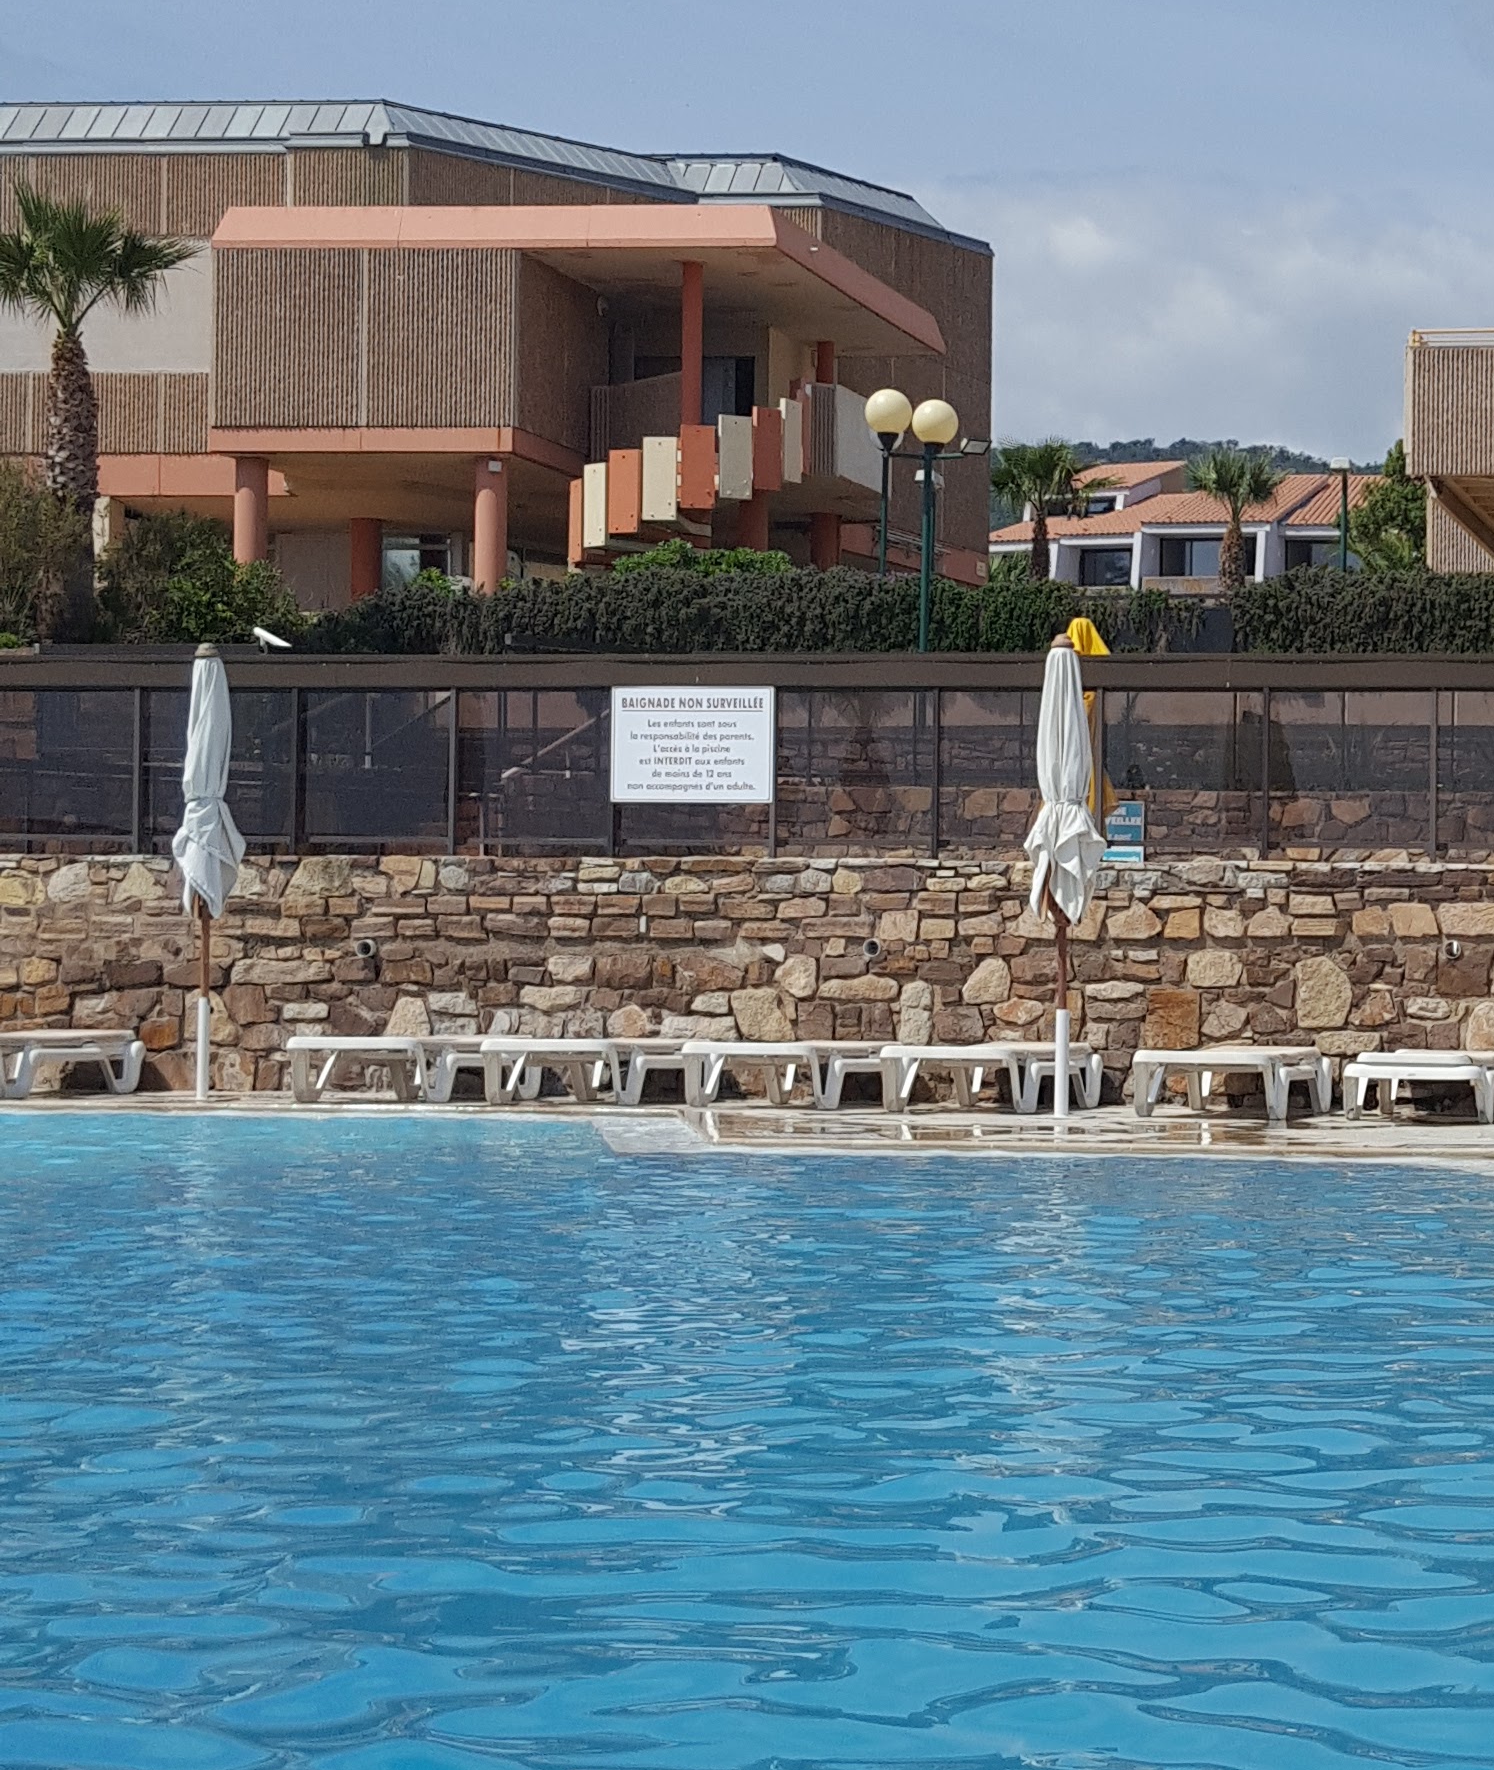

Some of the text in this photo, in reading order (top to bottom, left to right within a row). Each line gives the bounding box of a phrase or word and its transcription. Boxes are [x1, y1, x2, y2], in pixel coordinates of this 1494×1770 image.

[621, 696, 764, 708] BAIGNADE NON SURVEILLÉE
[647, 719, 661, 728] Les
[663, 719, 694, 728] enfants
[697, 720, 715, 728] sont
[630, 731, 755, 742] la responsabilité des parents.
[653, 744, 731, 755] L'accès à la piscine
[639, 756, 745, 766] est INTERDIT aux enfants
[651, 768, 662, 778] de
[664, 769, 690, 778] moins
[692, 769, 703, 778] de
[706, 769, 714, 778] 12
[705, 781, 724, 790] d'un
[726, 781, 756, 790] adulte.
